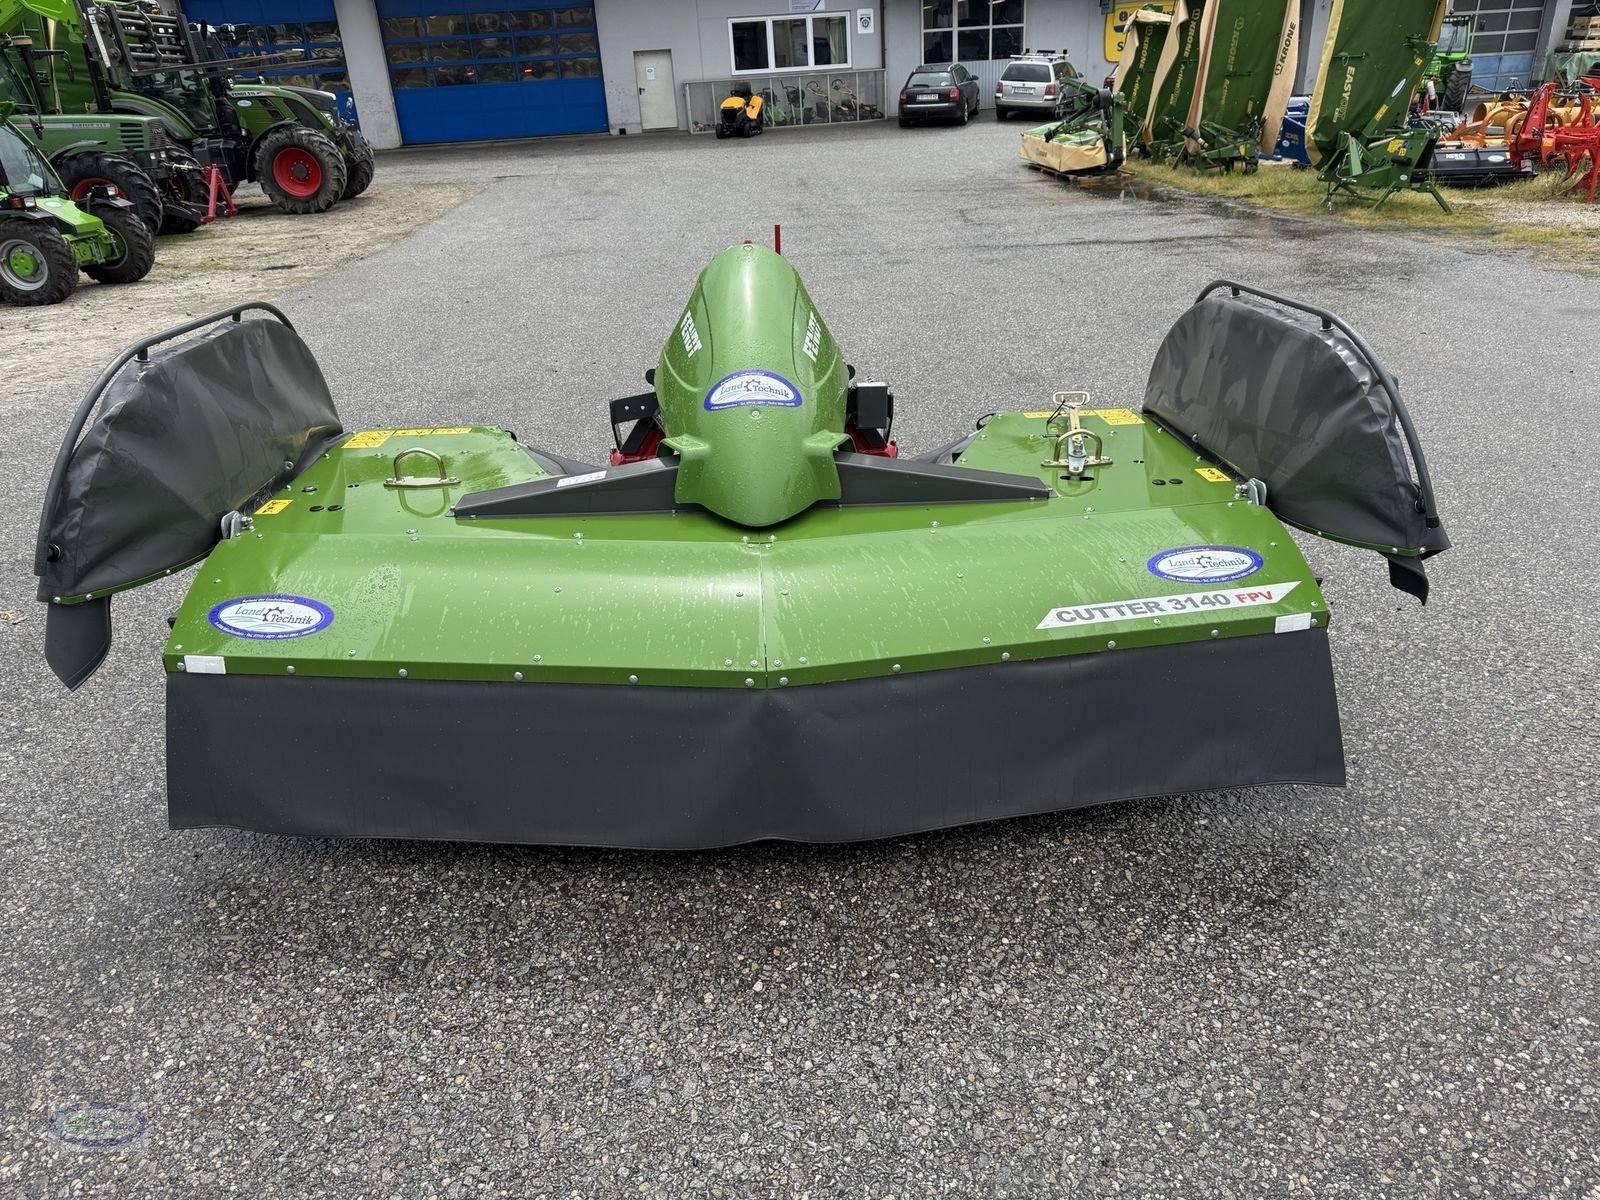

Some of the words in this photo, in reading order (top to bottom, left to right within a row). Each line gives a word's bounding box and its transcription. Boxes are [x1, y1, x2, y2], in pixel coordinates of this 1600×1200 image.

[1139, 35, 1150, 69] KRONE
[1184, 20, 1197, 58] KRONE
[1227, 30, 1240, 72] KRONE
[1280, 21, 1297, 64] KRONE
[719, 381, 744, 396] Land
[752, 384, 790, 399] Technik
[1168, 557, 1196, 567] Land
[1206, 557, 1248, 568] Technik
[234, 605, 266, 616] Land
[271, 613, 314, 625] Technik
[1055, 600, 1167, 623] CUTTER
[1167, 593, 1232, 612] 3140
[1234, 591, 1274, 604] FPV
